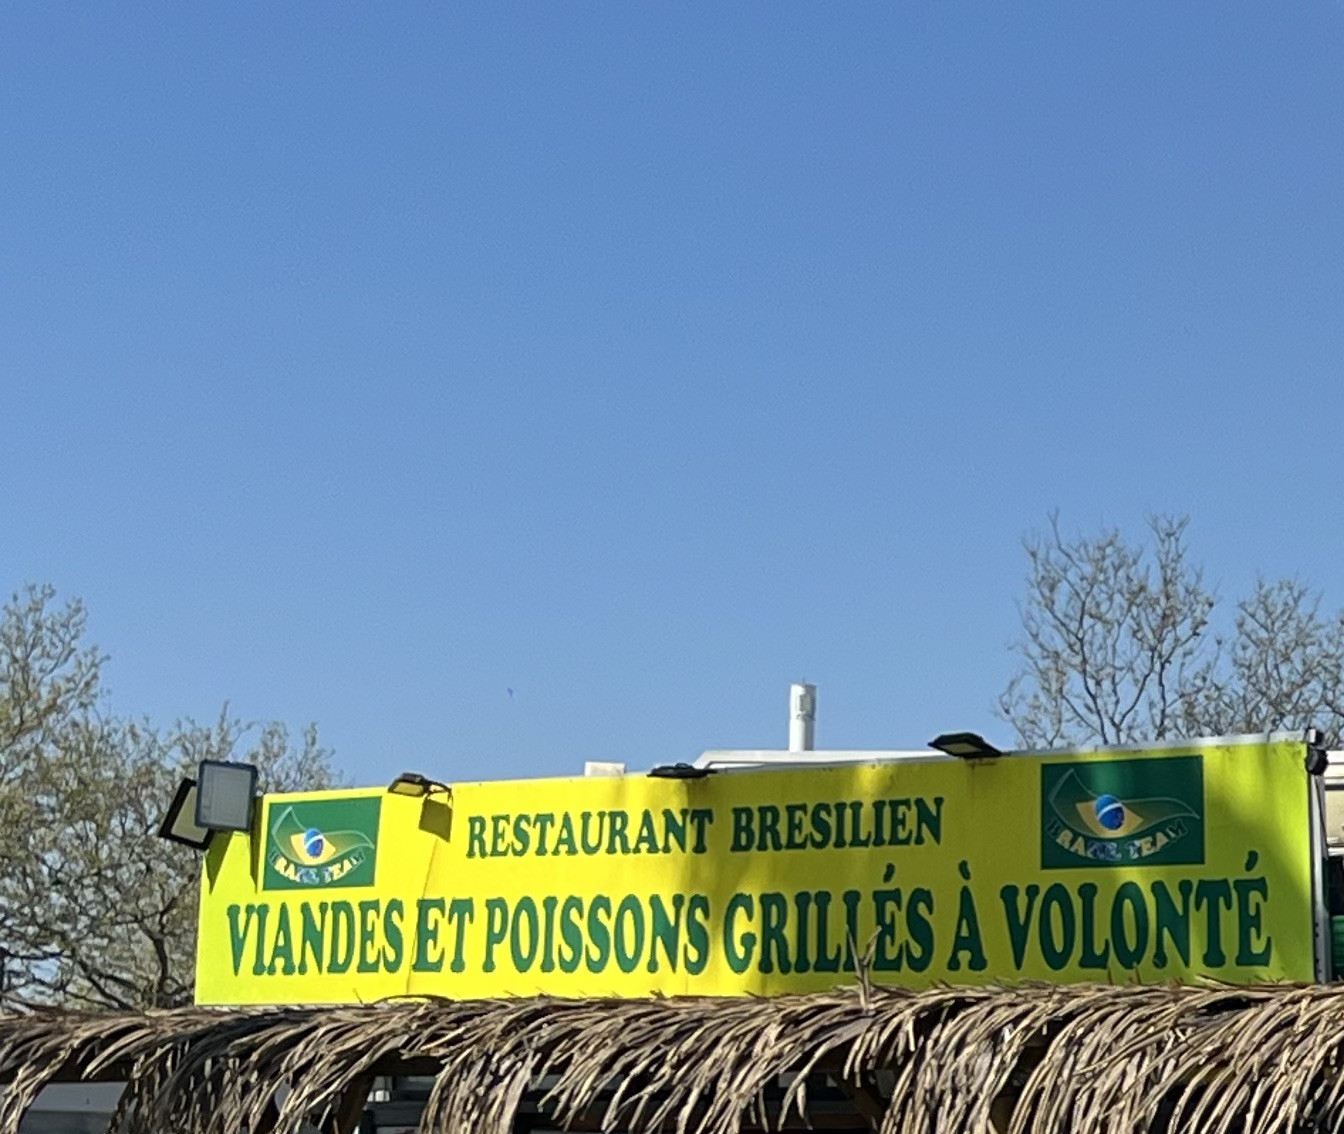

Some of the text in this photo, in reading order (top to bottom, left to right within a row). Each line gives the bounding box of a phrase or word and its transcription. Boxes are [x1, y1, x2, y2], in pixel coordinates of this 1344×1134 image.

[468, 796, 945, 858] RESTAURANT BRESILIEN
[1125, 818, 1189, 860] TEAM
[226, 850, 1272, 976] VIANDES ET POISSONS GRILLÉS À VOLONTÉ
